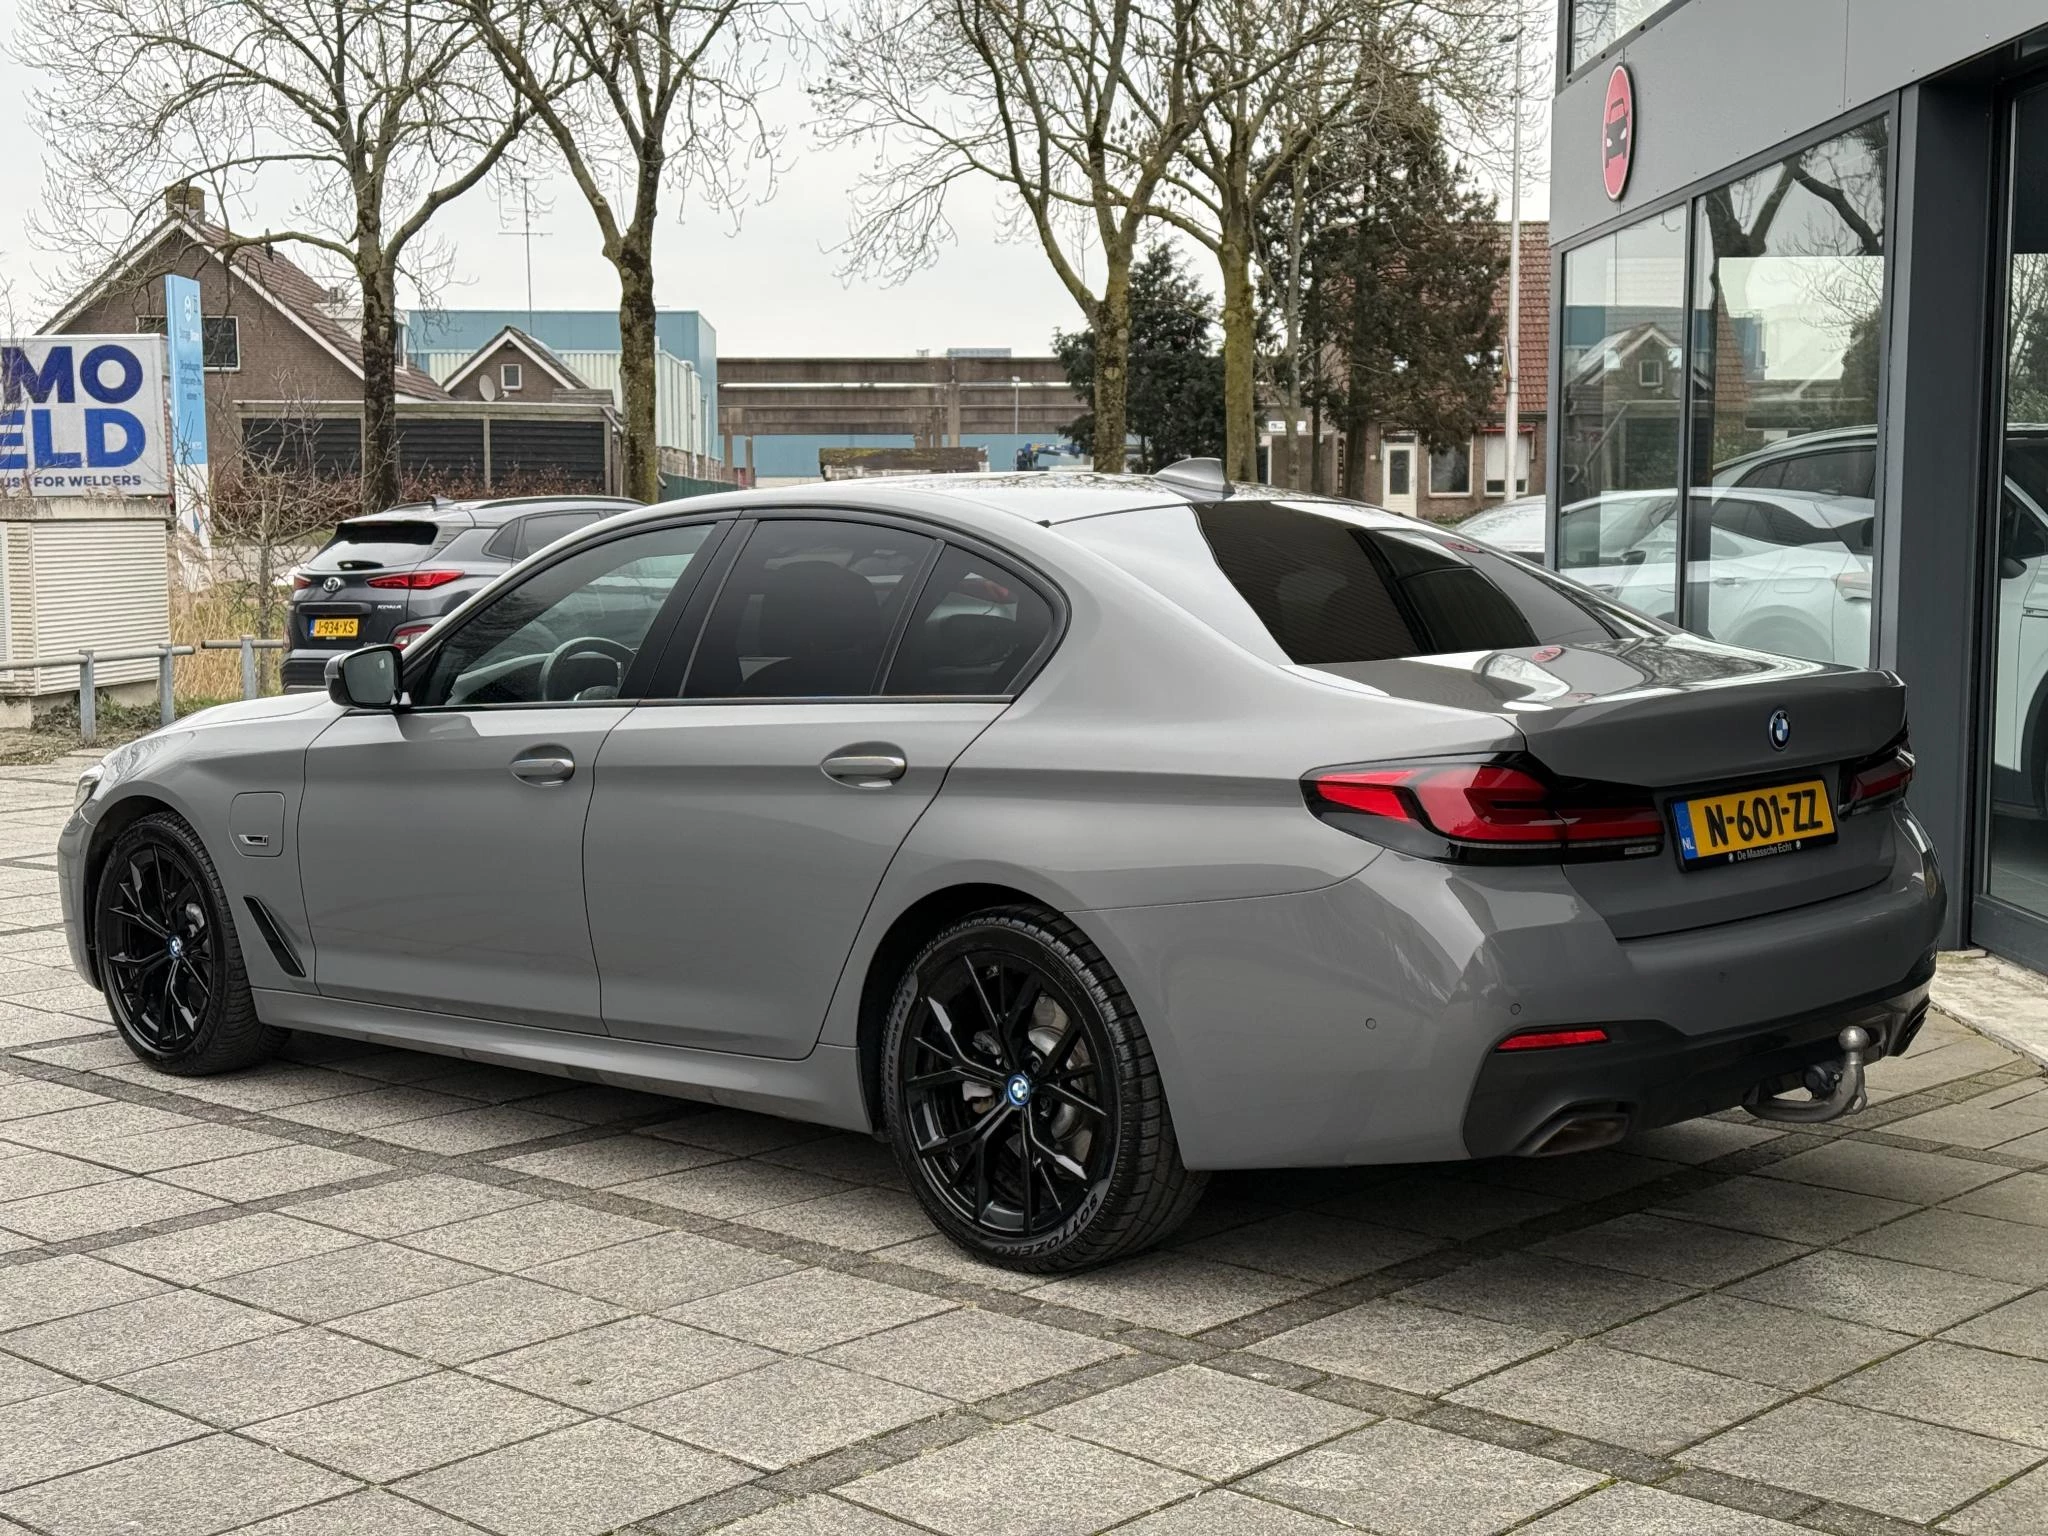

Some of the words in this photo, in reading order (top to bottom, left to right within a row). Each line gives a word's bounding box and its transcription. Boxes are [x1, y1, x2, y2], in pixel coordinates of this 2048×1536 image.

[1, 344, 143, 404] MO
[0, 408, 146, 469] ELD
[34, 476, 65, 488] FOR
[68, 475, 142, 488] WELDERS
[316, 621, 355, 635] J-934-XS
[1704, 788, 1824, 848] N-601-ZZ
[1682, 838, 1696, 851] NL
[1737, 850, 1747, 861] De
[1777, 842, 1793, 853] Echt
